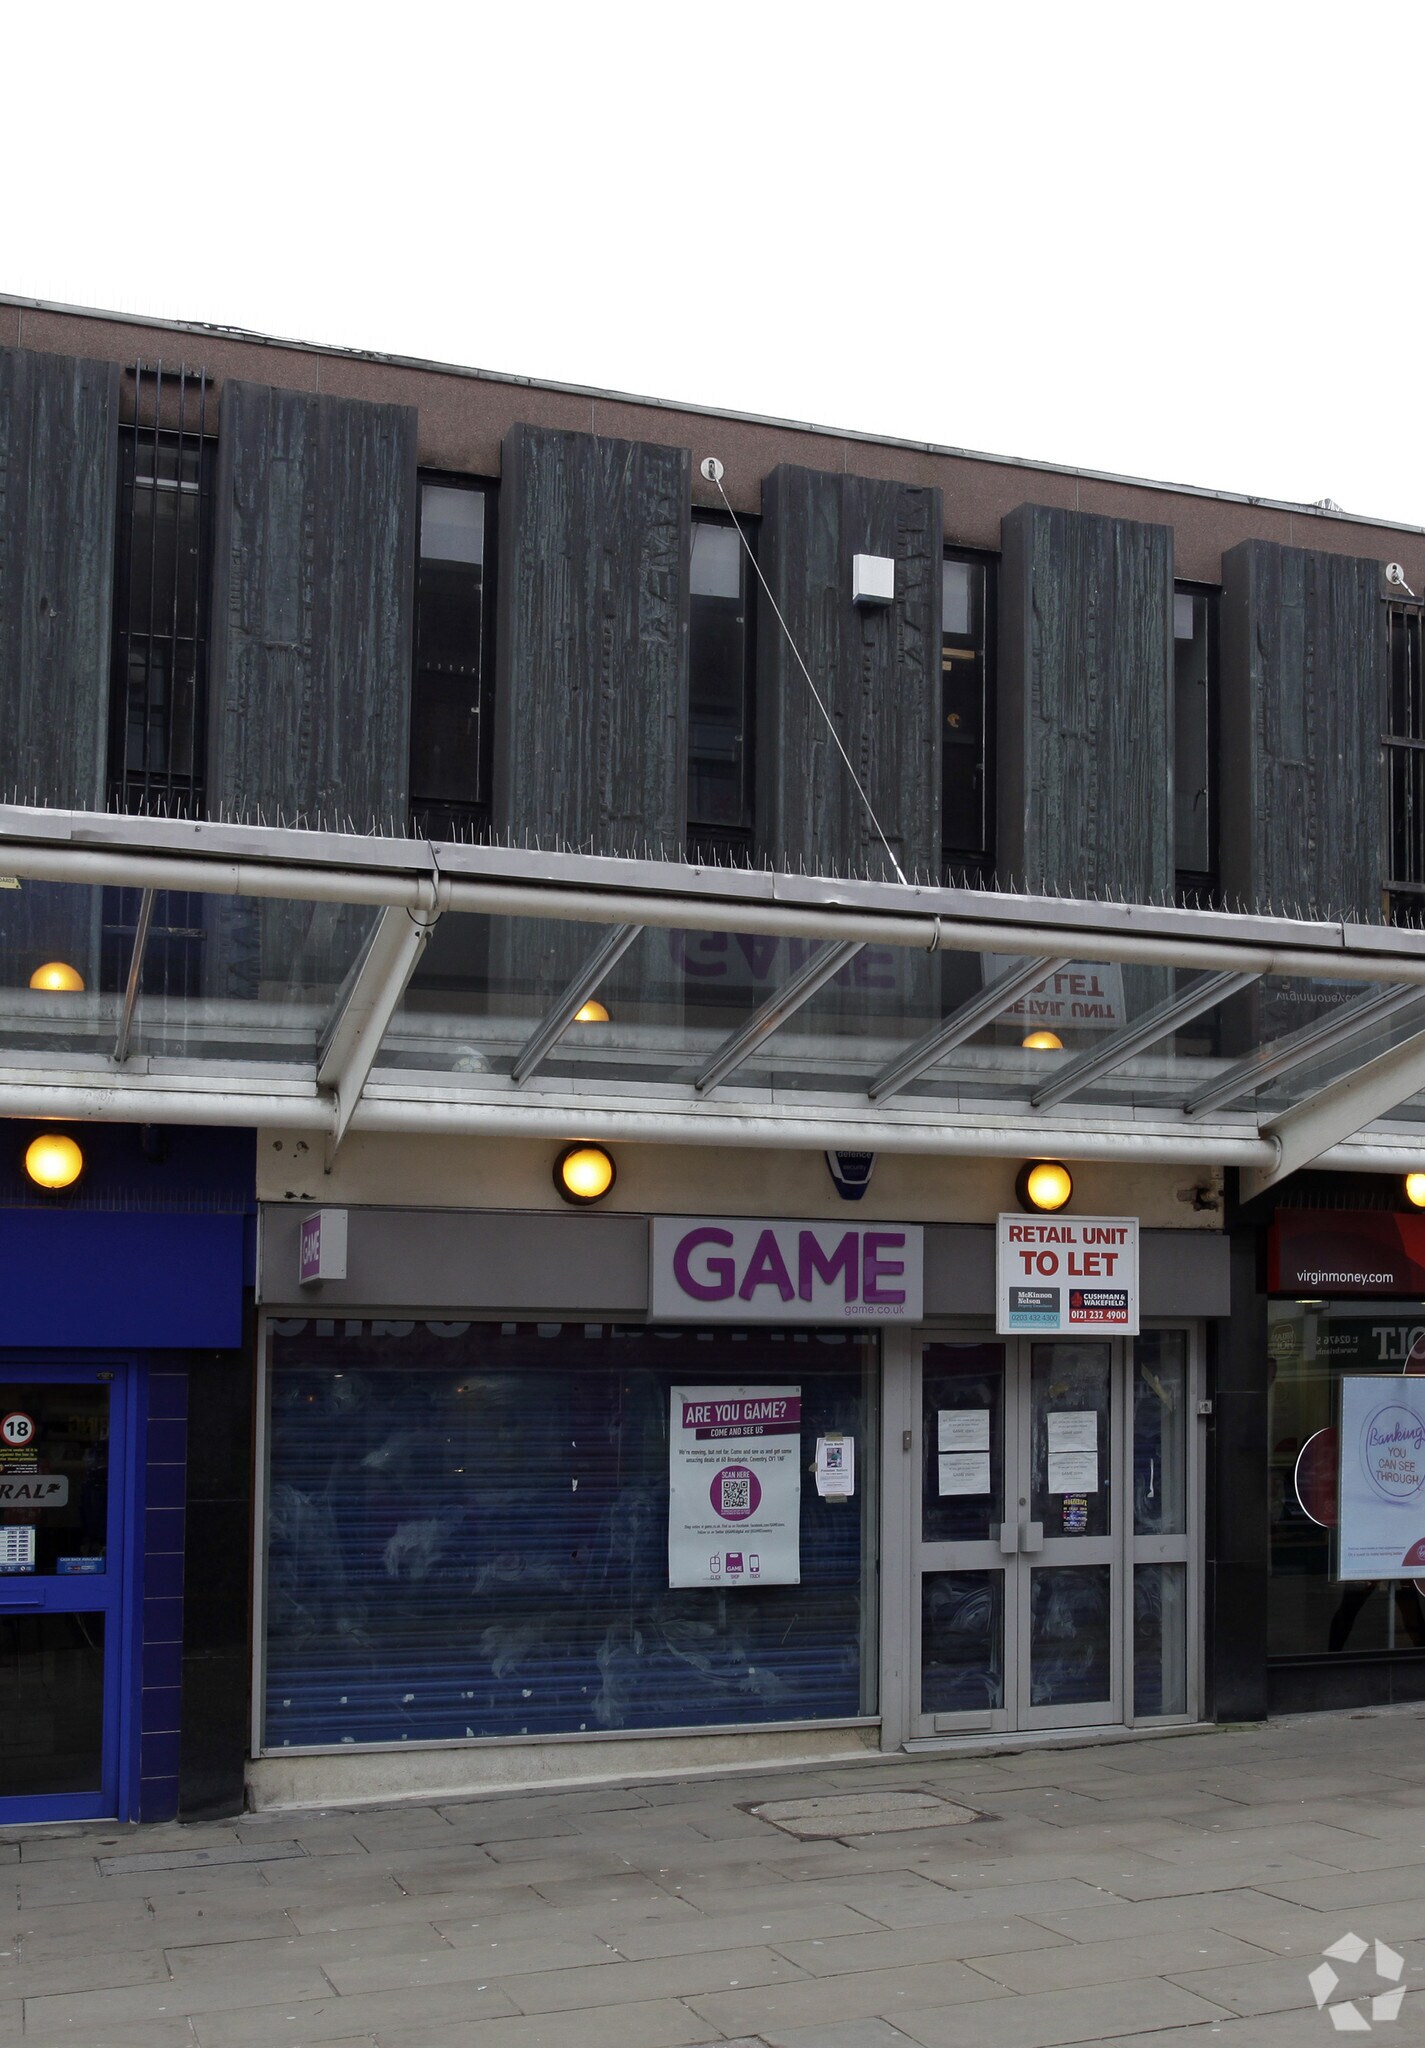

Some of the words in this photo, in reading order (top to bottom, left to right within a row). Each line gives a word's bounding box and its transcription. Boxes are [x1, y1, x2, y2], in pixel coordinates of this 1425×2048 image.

[1009, 1225, 1077, 1244] RETAIL
[1082, 1227, 1128, 1245] UNIT
[303, 1230, 319, 1265] GAME
[673, 1226, 906, 1304] GAME
[1019, 1250, 1059, 1276] TO
[1067, 1251, 1119, 1277] LET
[1296, 1269, 1394, 1286] virginmoney.com
[1018, 1291, 1053, 1299] McKinnon
[844, 1304, 905, 1317] game.co.uk
[1084, 1299, 1124, 1307] WAKEFIELD
[1071, 1310, 1087, 1319] 0121
[1089, 1311, 1104, 1319] 232
[1106, 1311, 1126, 1320] 4900
[685, 1405, 711, 1424] ARE
[715, 1404, 739, 1422] YOU
[743, 1401, 787, 1420] GAME?
[6, 1421, 29, 1437] 18
[710, 1427, 728, 1437] COME
[729, 1427, 742, 1436] AND
[743, 1426, 754, 1435] SEE
[755, 1425, 764, 1434] US
[1369, 1421, 1425, 1450] Banking
[1388, 1446, 1407, 1459] YOU
[1378, 1458, 1397, 1470] CAN
[1398, 1461, 1416, 1473] SEE
[721, 1471, 736, 1479] SCAN
[736, 1470, 750, 1478] HERE
[1375, 1470, 1419, 1485] THROUGH
